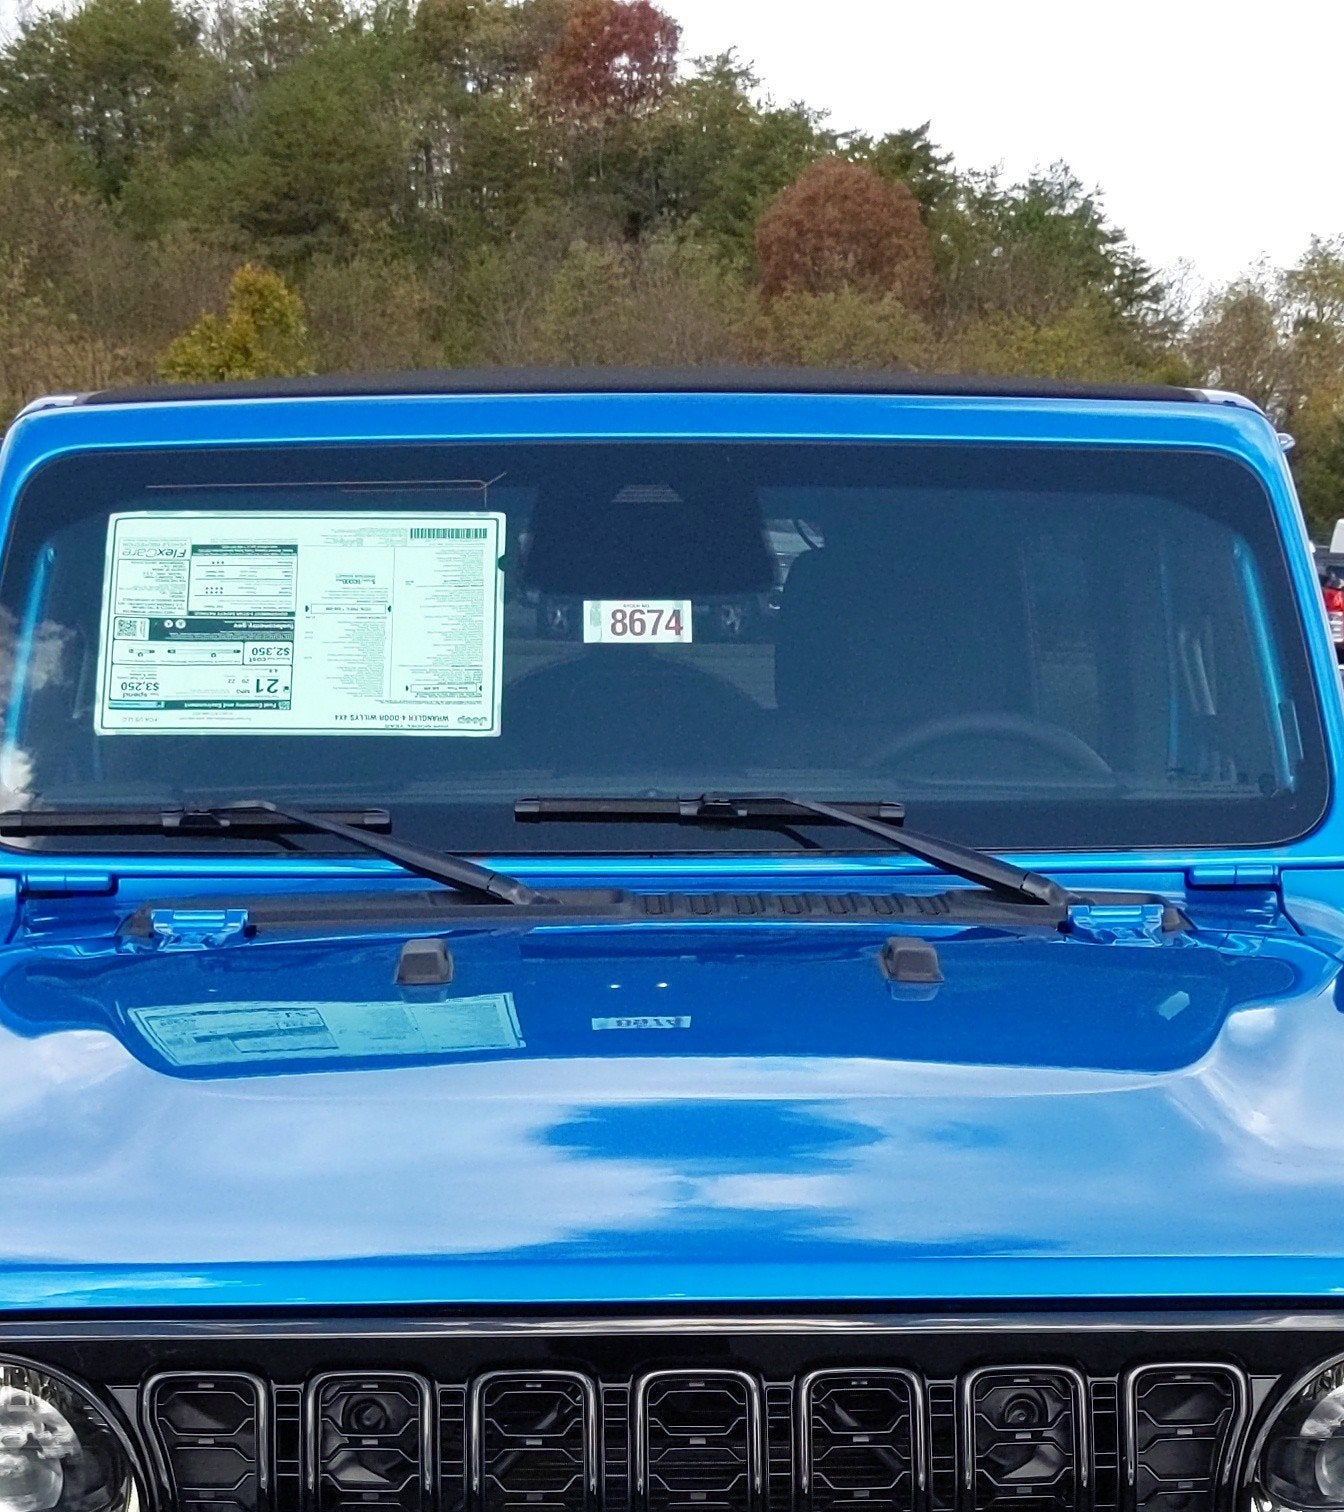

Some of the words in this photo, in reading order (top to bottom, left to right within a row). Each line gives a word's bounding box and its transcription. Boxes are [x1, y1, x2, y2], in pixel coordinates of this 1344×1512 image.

[122, 548, 187, 558] FlexCare
[610, 608, 684, 637] 8674
[251, 646, 291, 656] $2,350
[120, 681, 160, 691] $3,250
[255, 678, 279, 694] 21
[409, 714, 449, 722] WRANGLER
